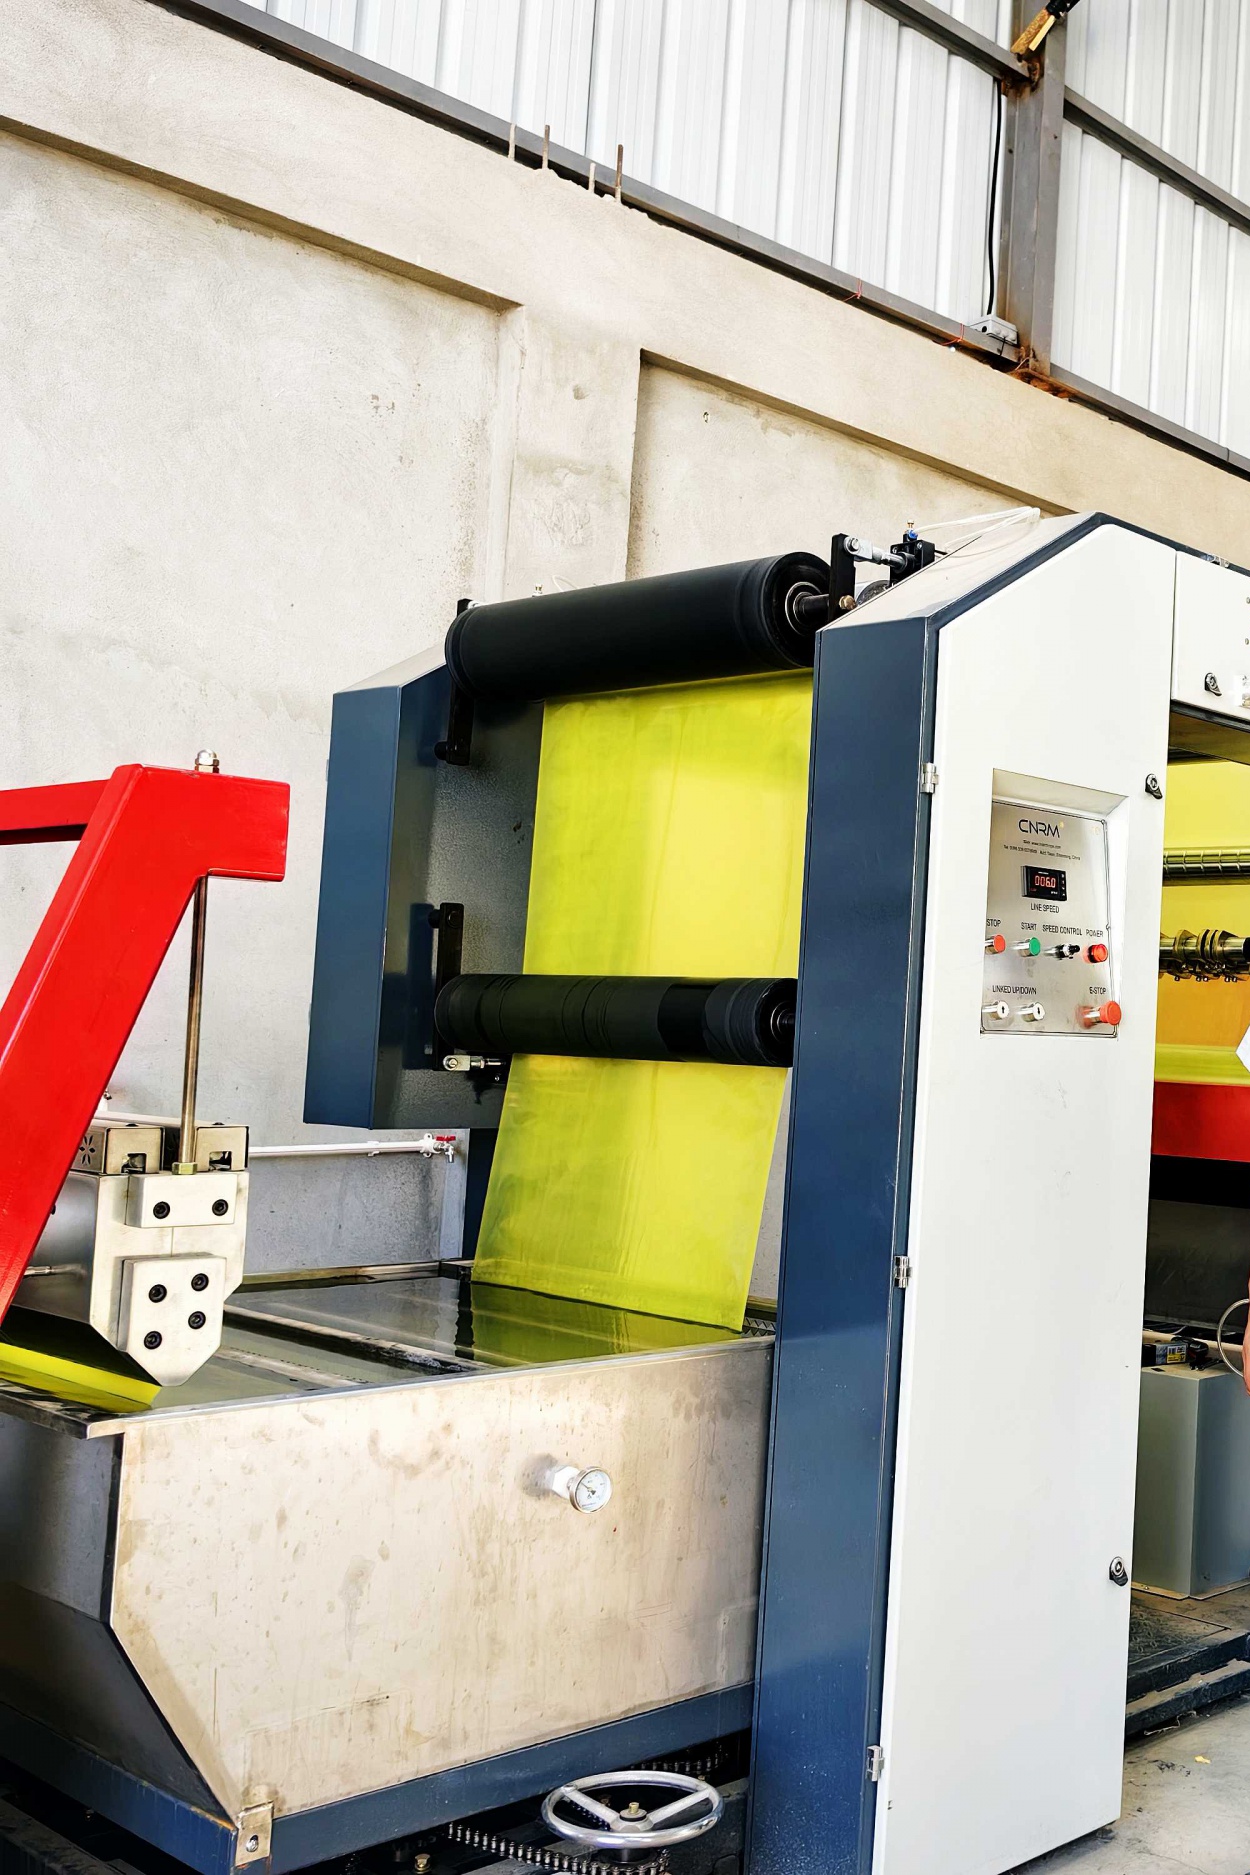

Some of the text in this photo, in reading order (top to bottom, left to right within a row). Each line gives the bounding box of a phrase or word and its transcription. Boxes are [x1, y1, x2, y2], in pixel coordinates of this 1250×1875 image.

[1018, 819, 1060, 838] CNRM
[1030, 902, 1060, 913] LINE SPEED
[986, 918, 1001, 927] STOP
[1021, 922, 1037, 931] START
[1042, 924, 1083, 936] SPEED CONTROL
[1085, 929, 1104, 938] POWER
[992, 984, 1011, 994] LINKED
[1089, 986, 1107, 995] E-STOP
